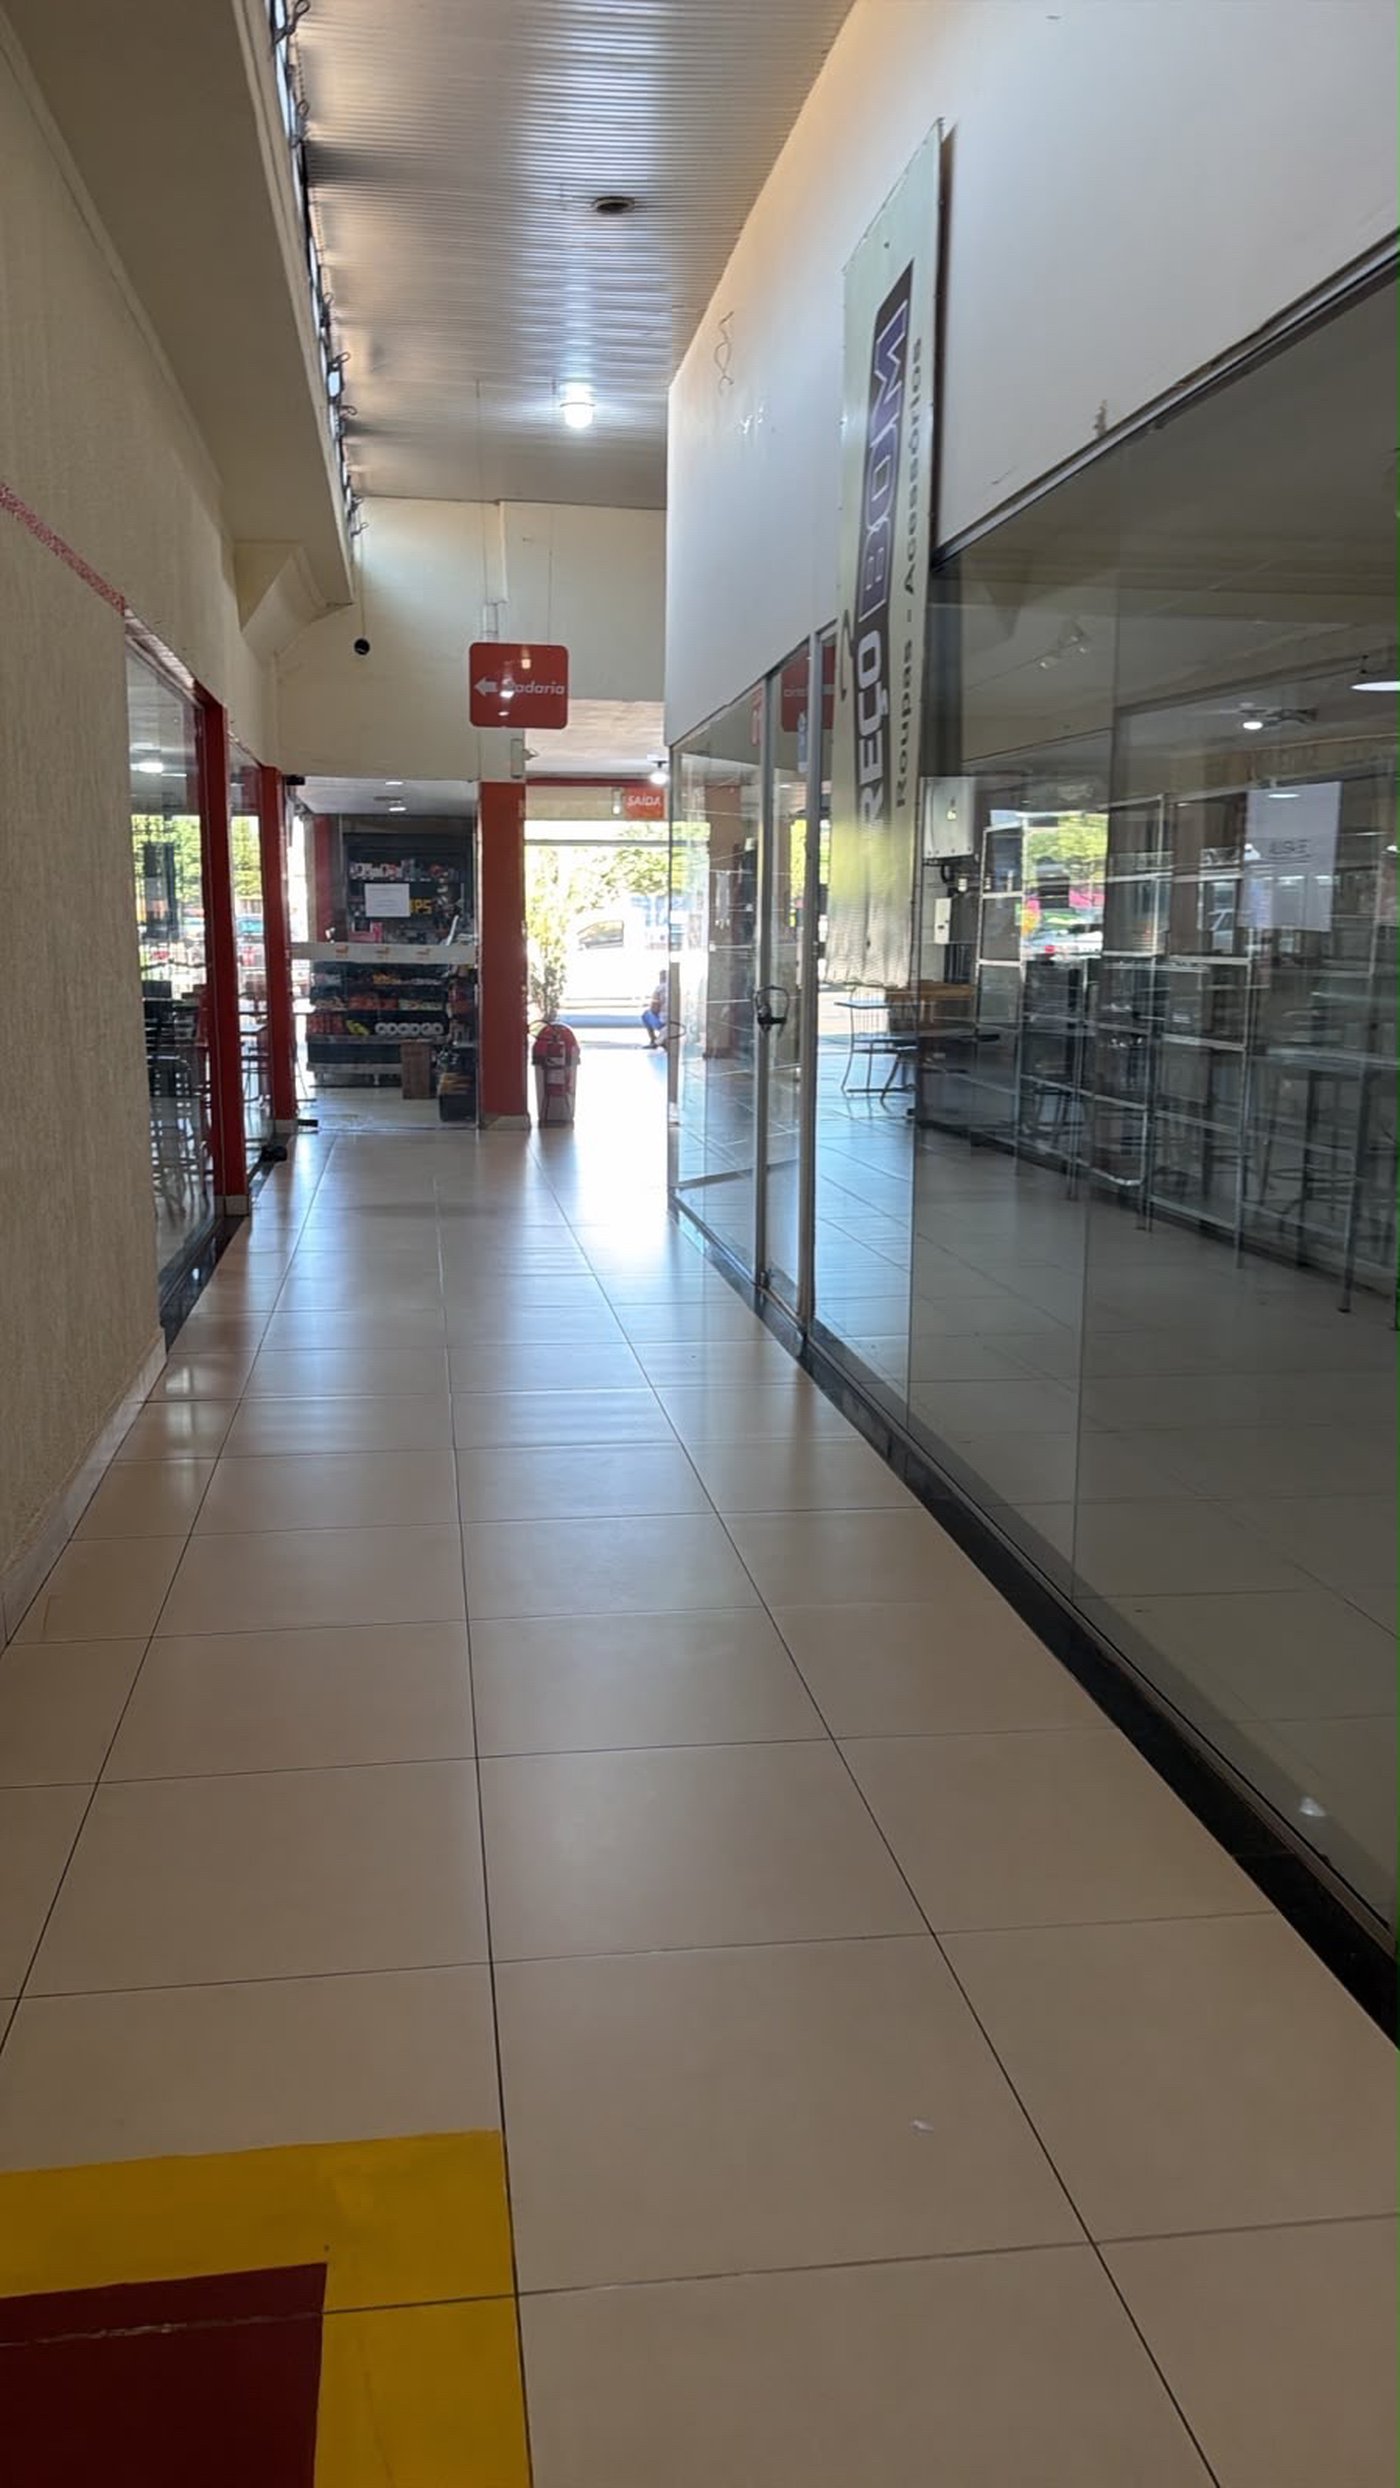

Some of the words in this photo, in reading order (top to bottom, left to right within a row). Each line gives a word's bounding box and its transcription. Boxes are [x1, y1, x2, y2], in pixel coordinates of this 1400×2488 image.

[858, 298, 909, 624] BOM
[504, 680, 565, 696] adaria
[896, 639, 912, 807] Roupas
